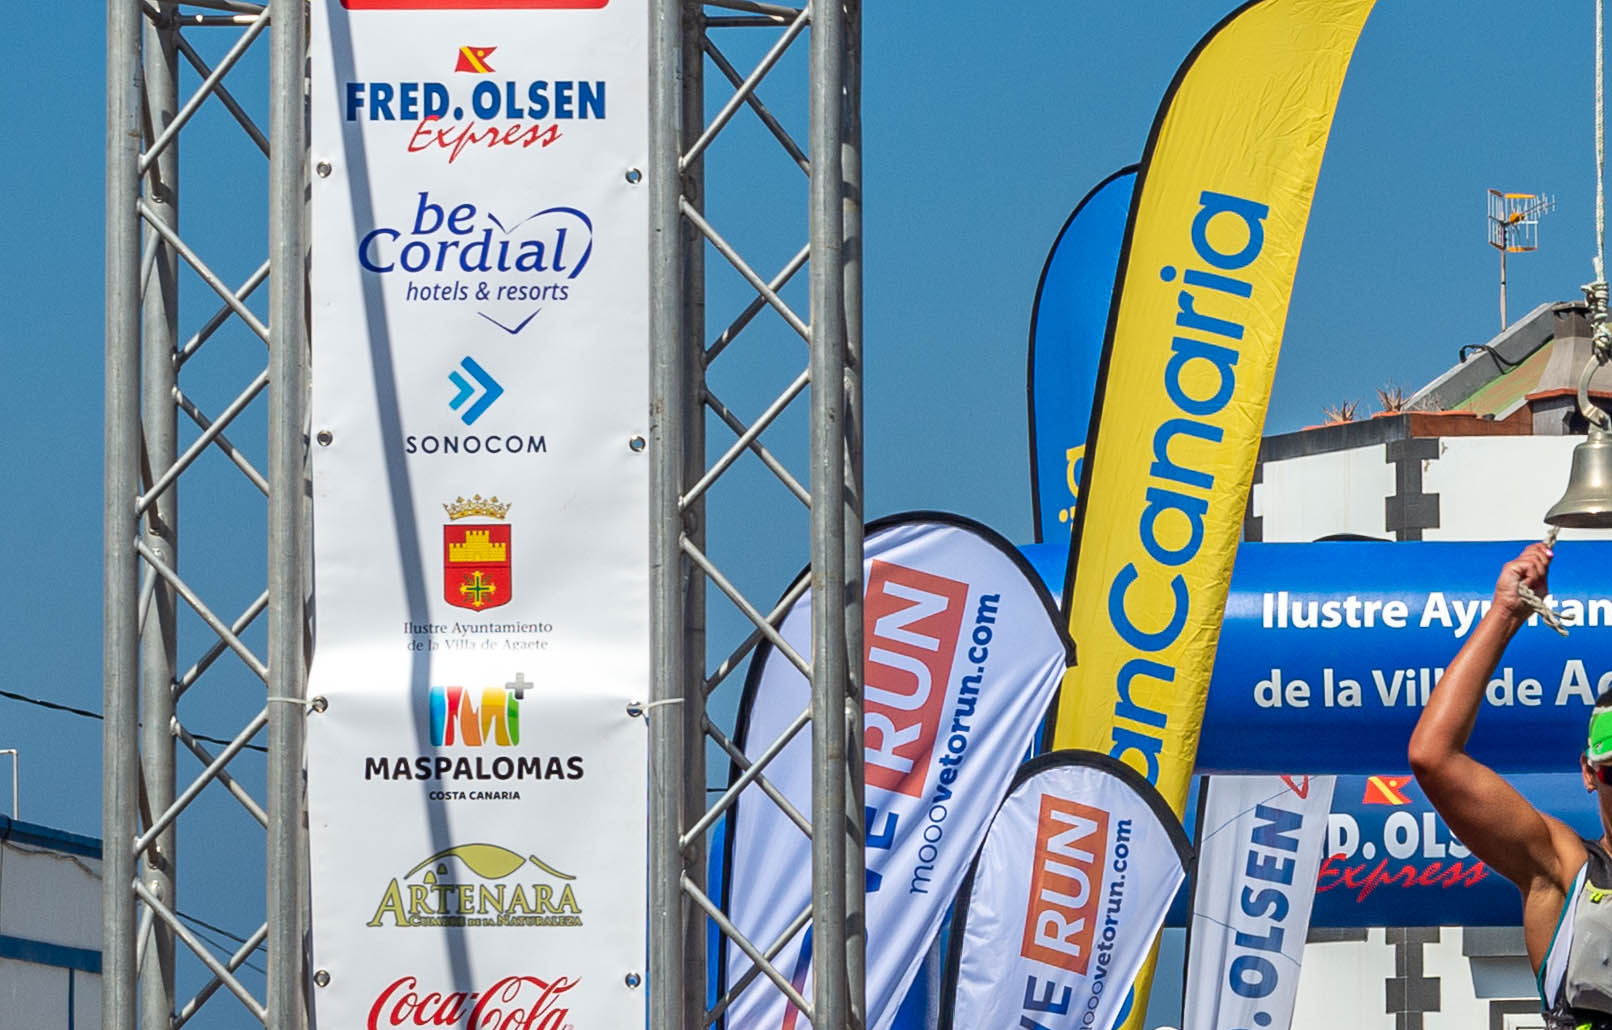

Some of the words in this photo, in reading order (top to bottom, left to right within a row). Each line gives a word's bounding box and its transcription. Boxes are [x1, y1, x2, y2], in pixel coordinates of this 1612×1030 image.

[407, 115, 563, 164] Express
[412, 192, 476, 235] be
[359, 228, 567, 273] Cordial
[406, 281, 468, 301] hotels
[476, 282, 489, 300] &
[497, 282, 568, 301] resorts
[406, 435, 547, 454] SONOCOM
[1108, 190, 1270, 789] anCanaria
[404, 622, 447, 635] Ilustre
[452, 621, 552, 637] Ayuntamiento
[1263, 591, 1408, 629] Ilustre
[408, 640, 424, 651] de
[428, 639, 439, 651] la
[445, 639, 476, 650] Villa
[481, 639, 497, 650] de
[504, 639, 549, 652] Agaete
[866, 581, 950, 775] RUN
[1253, 669, 1312, 708] de
[1323, 669, 1362, 707] la
[1372, 668, 1444, 708] Vill
[1486, 667, 1543, 707] de
[910, 593, 1001, 894] mooovetorun.com
[365, 755, 584, 780] MASPALOMAS
[429, 791, 466, 800] COSTA
[469, 791, 521, 800] CANARIA
[1035, 809, 1099, 957] RUN
[1318, 853, 1489, 903] Express
[367, 878, 582, 927] ARTENARA
